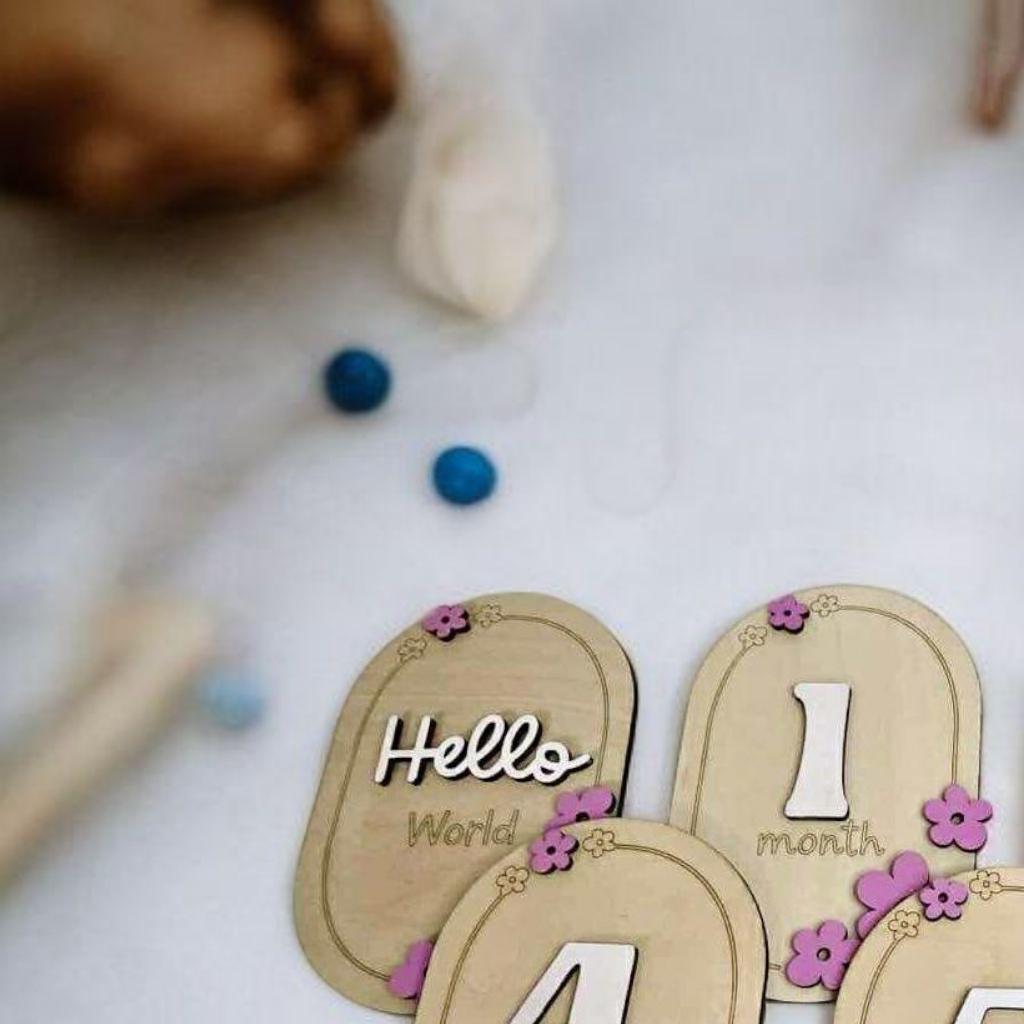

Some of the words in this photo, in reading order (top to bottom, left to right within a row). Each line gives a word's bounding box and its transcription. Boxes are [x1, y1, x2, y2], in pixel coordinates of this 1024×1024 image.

[373, 714, 593, 785] Hello
[784, 682, 852, 820] 1
[407, 809, 516, 849] World
[756, 817, 886, 857] month
